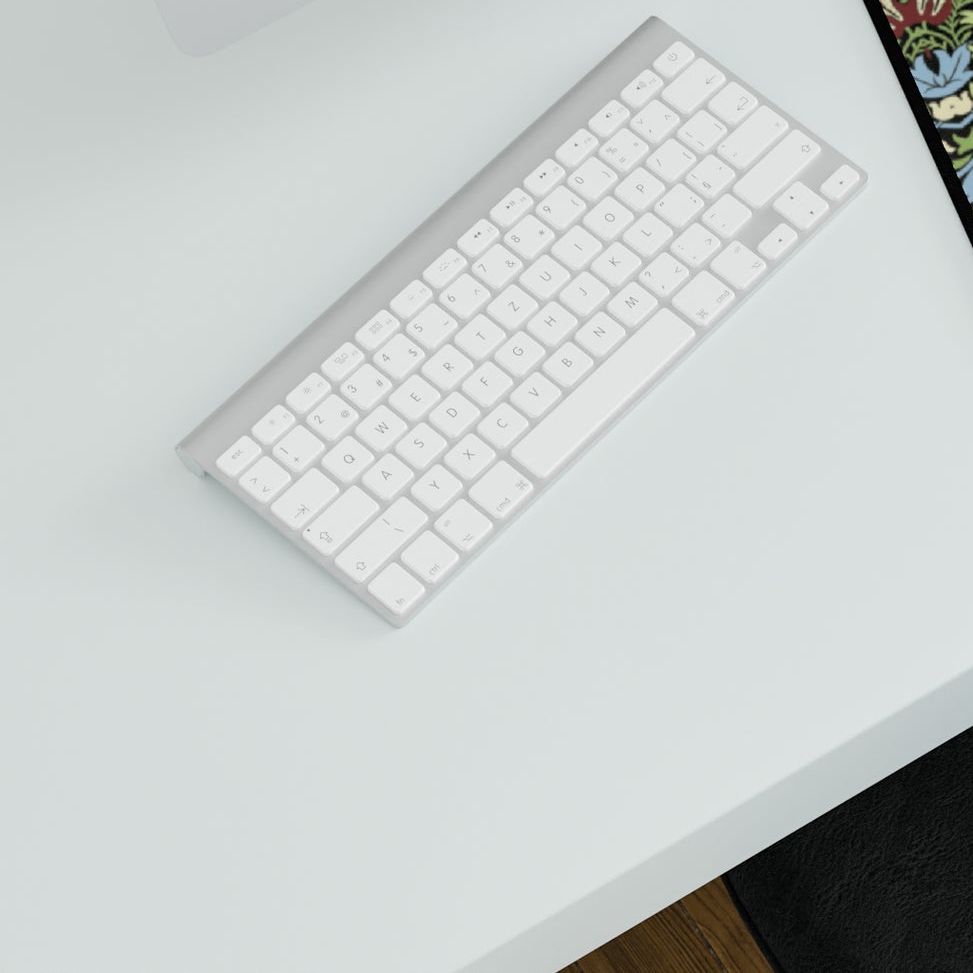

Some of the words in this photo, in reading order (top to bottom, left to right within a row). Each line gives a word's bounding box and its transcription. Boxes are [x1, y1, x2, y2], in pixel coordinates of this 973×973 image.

[313, 414, 325, 425] 2
[346, 384, 358, 394] 3
[381, 353, 391, 362] 4
[413, 323, 424, 333] 5
[446, 293, 457, 303] 6
[477, 263, 487, 273] 7
[510, 234, 521, 244] 8
[542, 205, 552, 213] 9
[574, 176, 585, 185] 0
[343, 454, 356, 465] Q
[374, 420, 390, 435] W
[409, 391, 422, 403] E
[442, 362, 455, 372] R
[474, 330, 486, 340] T
[507, 300, 521, 313] Z
[538, 270, 553, 282] U
[604, 212, 616, 223] O
[635, 183, 645, 194] P
[380, 470, 393, 481] A
[413, 438, 425, 449] S
[445, 407, 458, 419] D
[479, 376, 489, 387] F
[512, 346, 524, 357] G
[543, 315, 557, 328] H
[578, 286, 588, 297] J
[608, 256, 621, 267] K
[640, 229, 653, 238] L
[428, 479, 440, 490] Y
[462, 448, 476, 461] X
[496, 418, 509, 429] C
[527, 387, 540, 397] V
[560, 357, 573, 368] B
[592, 326, 607, 338] N
[624, 296, 640, 309] M
[231, 448, 244, 460] esc
